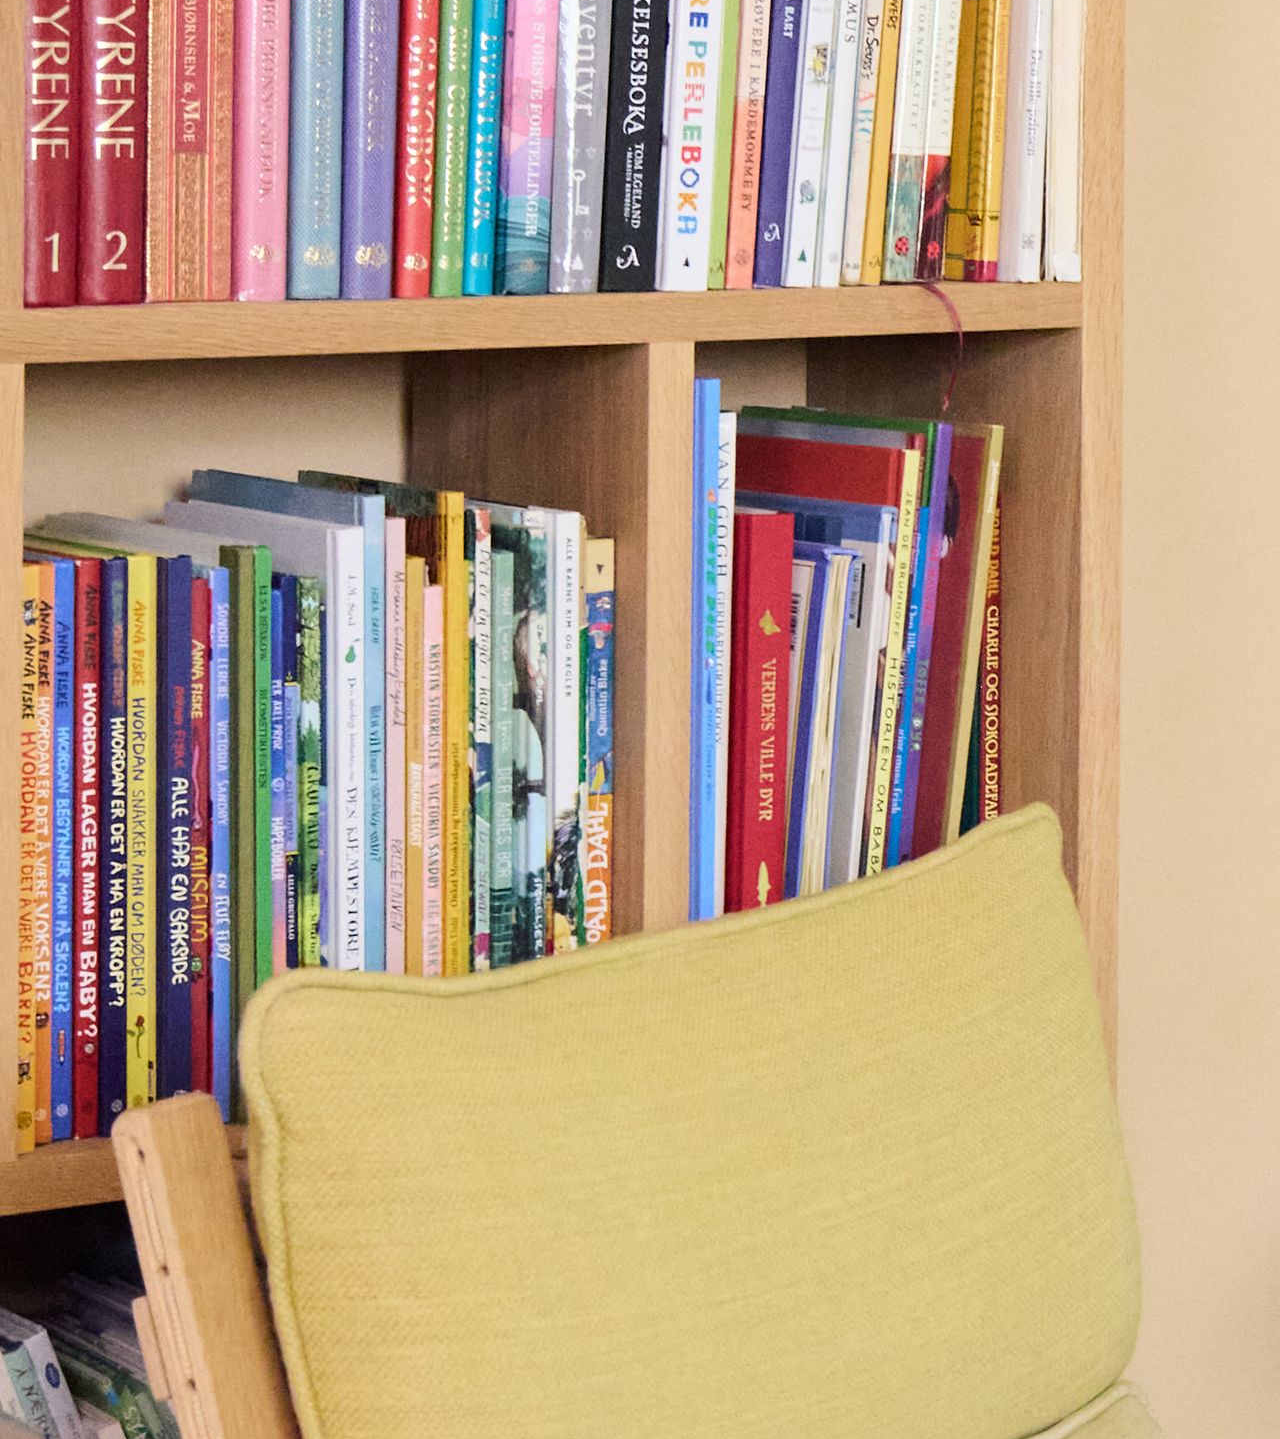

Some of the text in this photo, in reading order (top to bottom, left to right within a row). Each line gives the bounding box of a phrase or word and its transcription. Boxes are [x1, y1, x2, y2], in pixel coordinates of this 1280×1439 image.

[782, 6, 796, 39] RART
[183, 82, 195, 93] &
[1029, 50, 1043, 77] Den
[676, 41, 707, 235] PERLEBOKA
[742, 77, 760, 189] KARDEMOMME
[525, 103, 543, 237] FORTELLINGER
[630, 142, 645, 229] TOM EGELAND
[741, 193, 753, 213] BY
[45, 233, 59, 272] 1
[104, 231, 128, 272] 2
[717, 442, 729, 490] VAN
[565, 635, 572, 650] OG
[985, 605, 999, 701] CHARLIE OG
[36, 600, 52, 776] ANNA FISKE HVORDAN
[191, 639, 205, 719] ANNA FISKE
[110, 717, 126, 796] HVORDAN
[758, 657, 777, 821] VERDENS VILLE DYR
[56, 727, 70, 876] HVORDAN BEGYNNER
[81, 682, 97, 945] HVORDAN LAGER MAN EN
[111, 800, 125, 819] ER
[585, 803, 610, 869] DAHL
[111, 823, 124, 854] DET
[132, 697, 146, 997] HVORDAN SNAKKER MAN OM DØDEN?
[18, 732, 36, 1043] HVORDAN ER BARN?
[111, 879, 125, 903] HA
[111, 908, 124, 931] EN
[108, 936, 125, 1007] KROPP?
